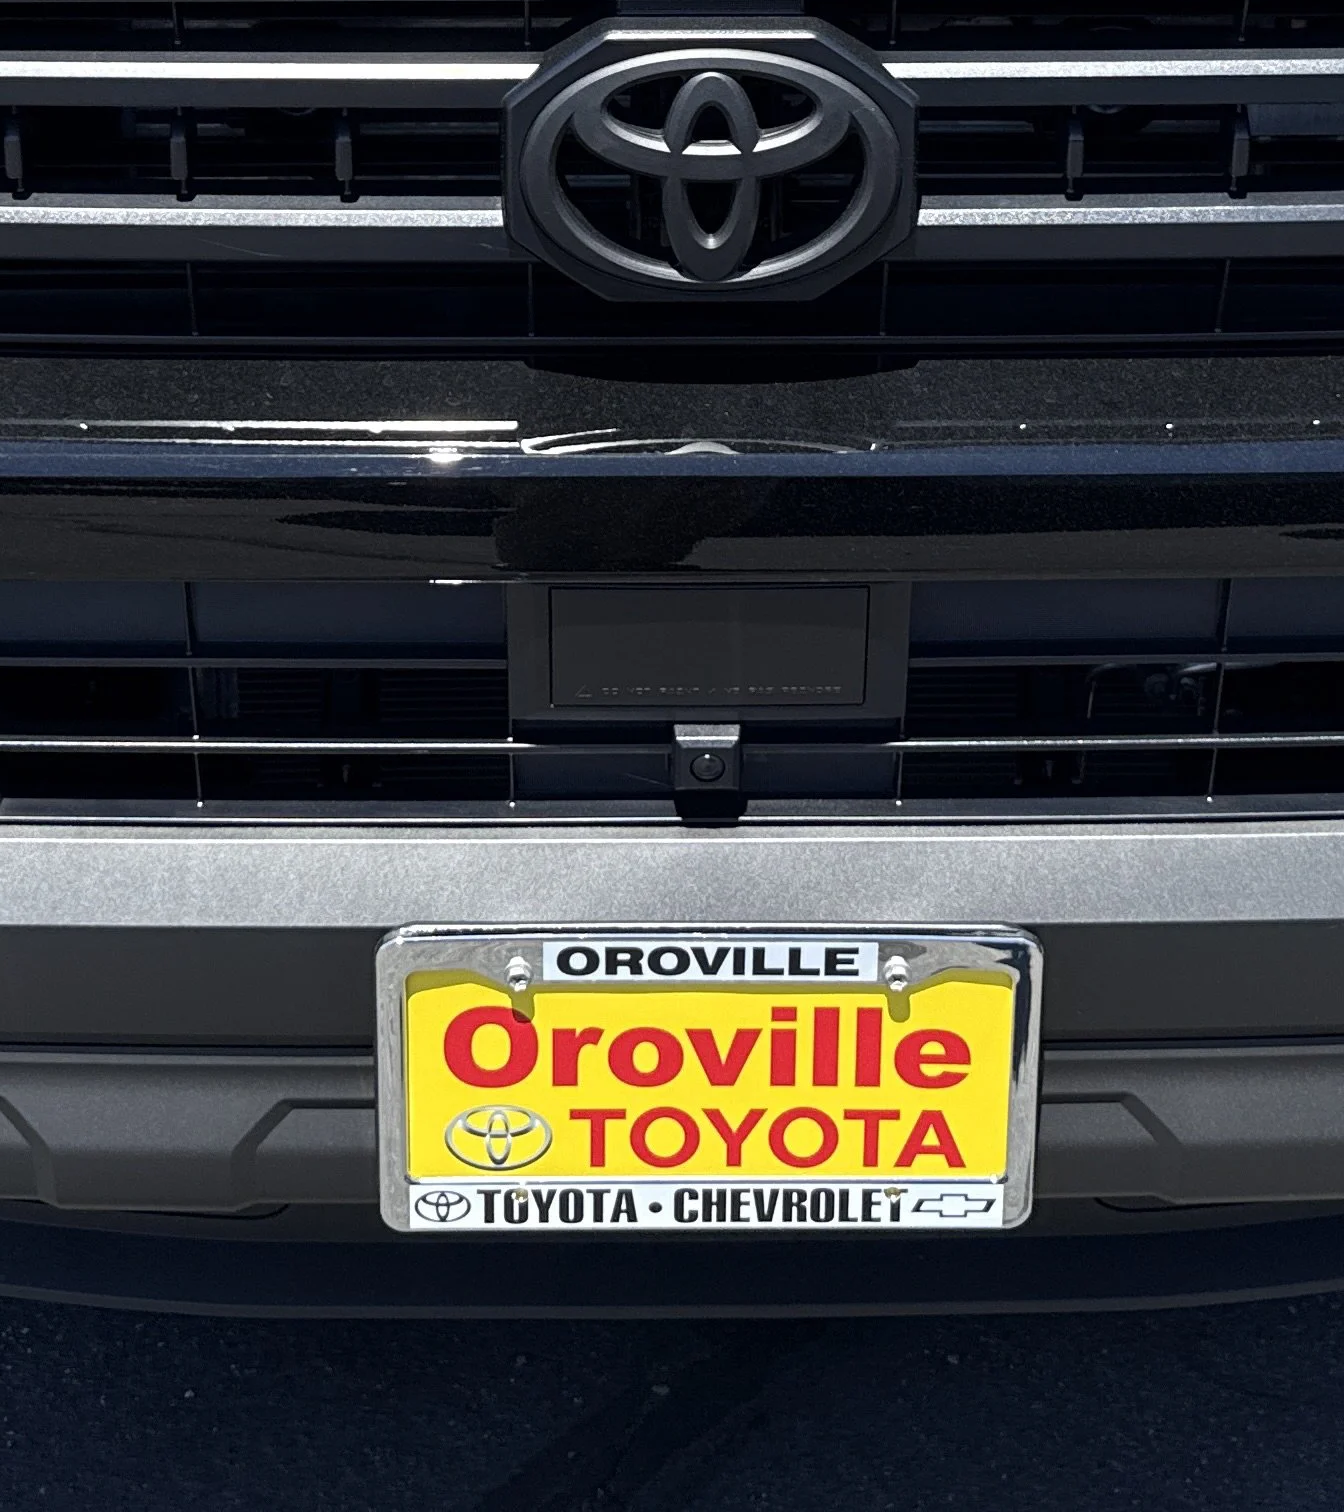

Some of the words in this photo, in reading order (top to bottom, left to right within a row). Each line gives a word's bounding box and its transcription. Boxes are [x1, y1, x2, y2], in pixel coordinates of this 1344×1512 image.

[556, 946, 859, 976] OROVILLE
[443, 1005, 972, 1089] Oroville
[569, 1106, 967, 1169] TOYOTA
[476, 1187, 639, 1224] TOYOTA
[673, 1187, 909, 1224] CHEVROLET
